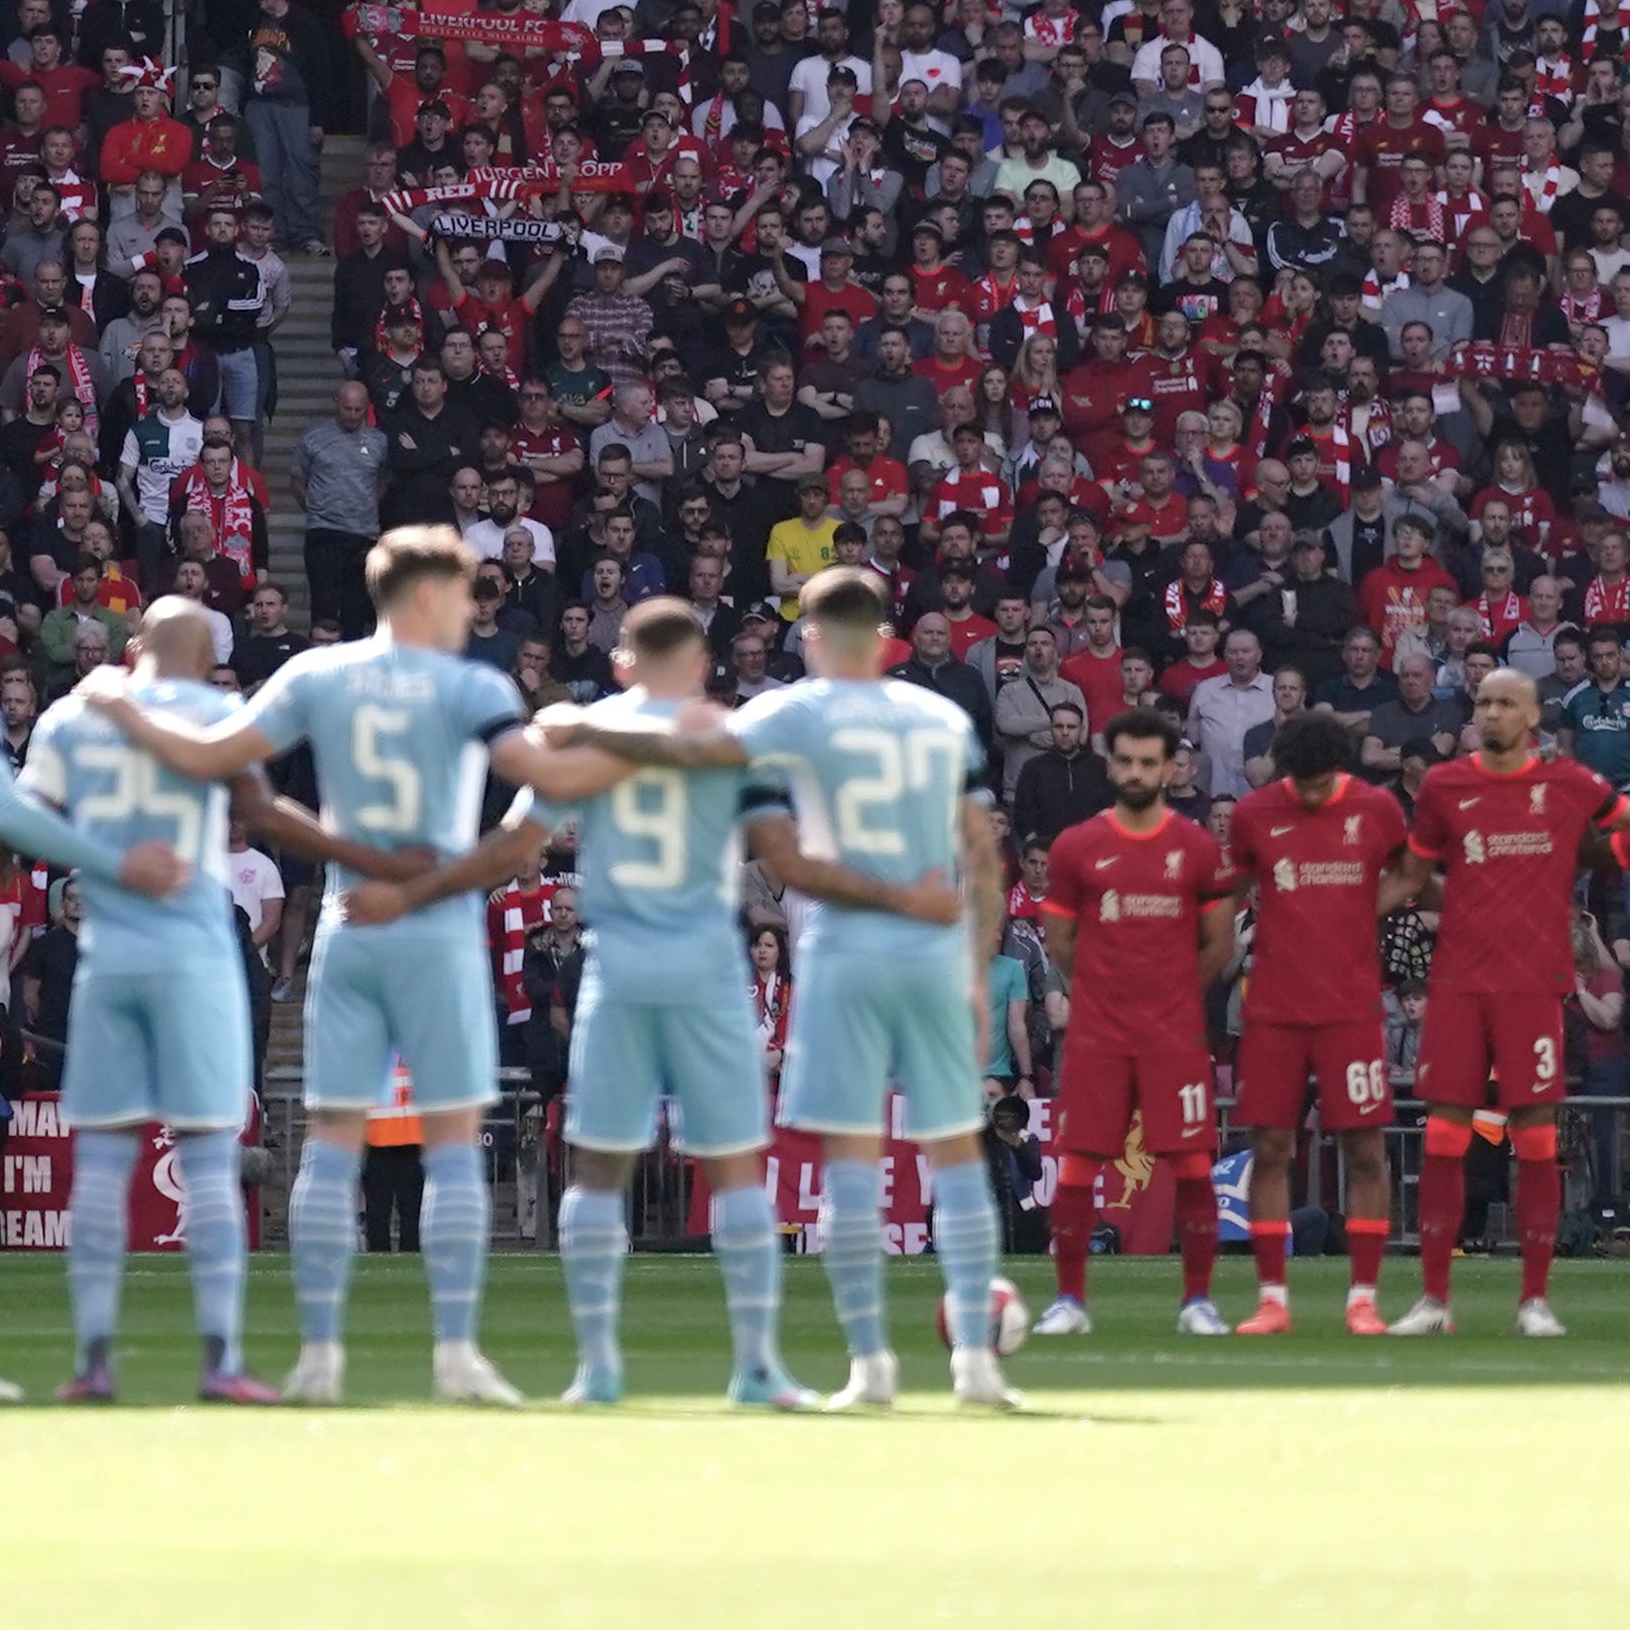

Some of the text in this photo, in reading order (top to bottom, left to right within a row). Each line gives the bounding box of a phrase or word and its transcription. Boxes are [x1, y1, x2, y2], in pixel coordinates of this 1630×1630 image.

[418, 12, 547, 35] LIVERPOOL FC
[556, 161, 624, 179] KOPP
[424, 181, 476, 202] RED
[437, 216, 554, 240] LIVERPOOL
[354, 706, 421, 832] 5
[610, 768, 686, 888] 9
[1533, 1036, 1555, 1080] 3
[1345, 1059, 1386, 1104] 66
[1178, 1082, 1207, 1124] 11
[3, 1155, 52, 1193] I'M
